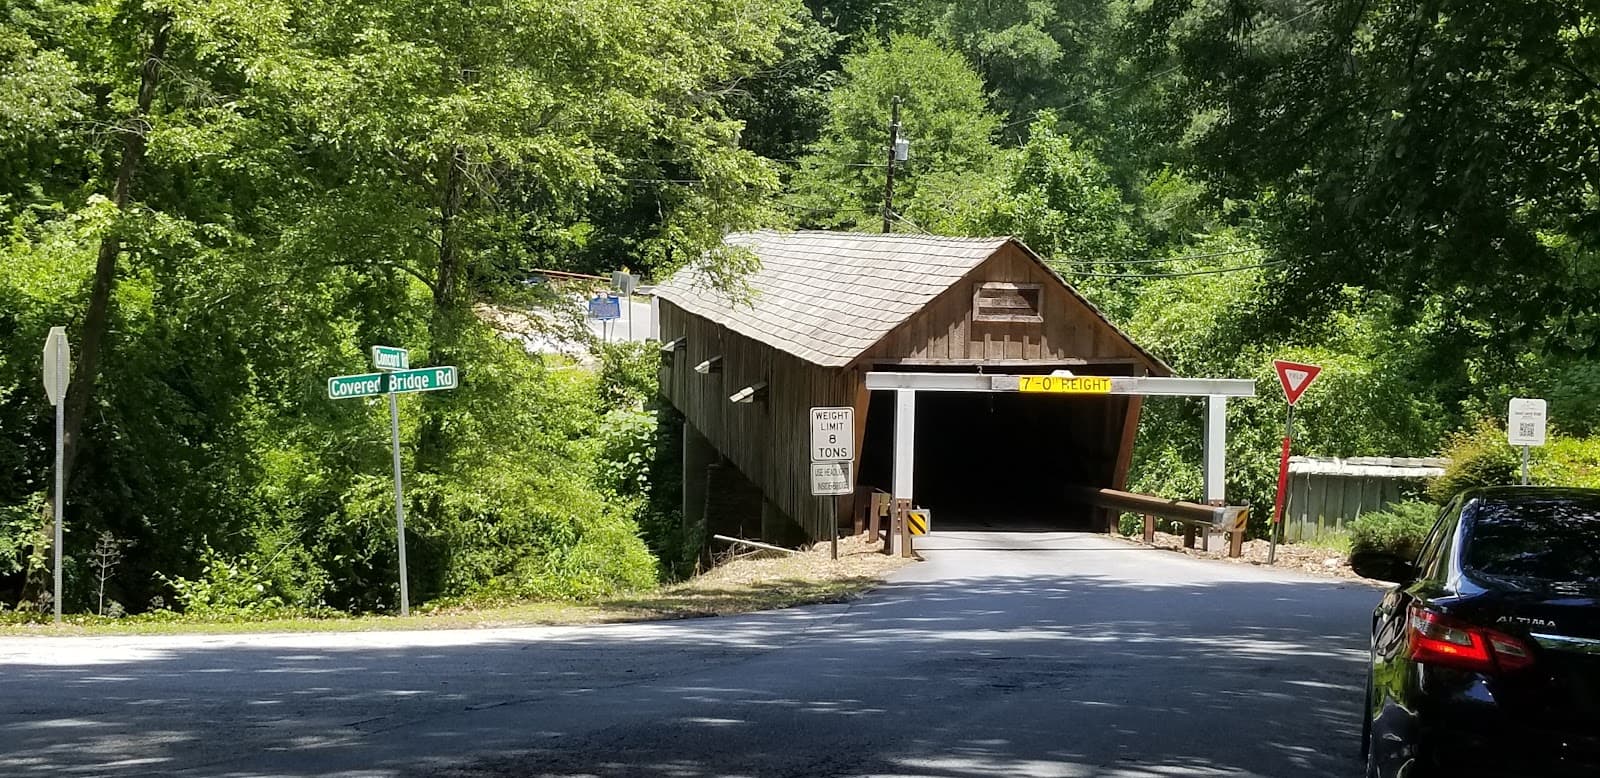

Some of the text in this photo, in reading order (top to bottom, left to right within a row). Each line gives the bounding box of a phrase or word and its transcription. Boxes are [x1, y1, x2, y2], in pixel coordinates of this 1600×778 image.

[376, 350, 400, 367] Concord
[331, 370, 452, 396] Covered Bridge Rd
[1062, 378, 1108, 391] HEIGHT
[816, 411, 849, 420] WEIGHT
[821, 422, 844, 431] LIMIT
[829, 434, 837, 444] 8
[819, 447, 847, 458] TONS
[824, 467, 849, 477] HEADL
[1496, 615, 1556, 627] ALTIMA
